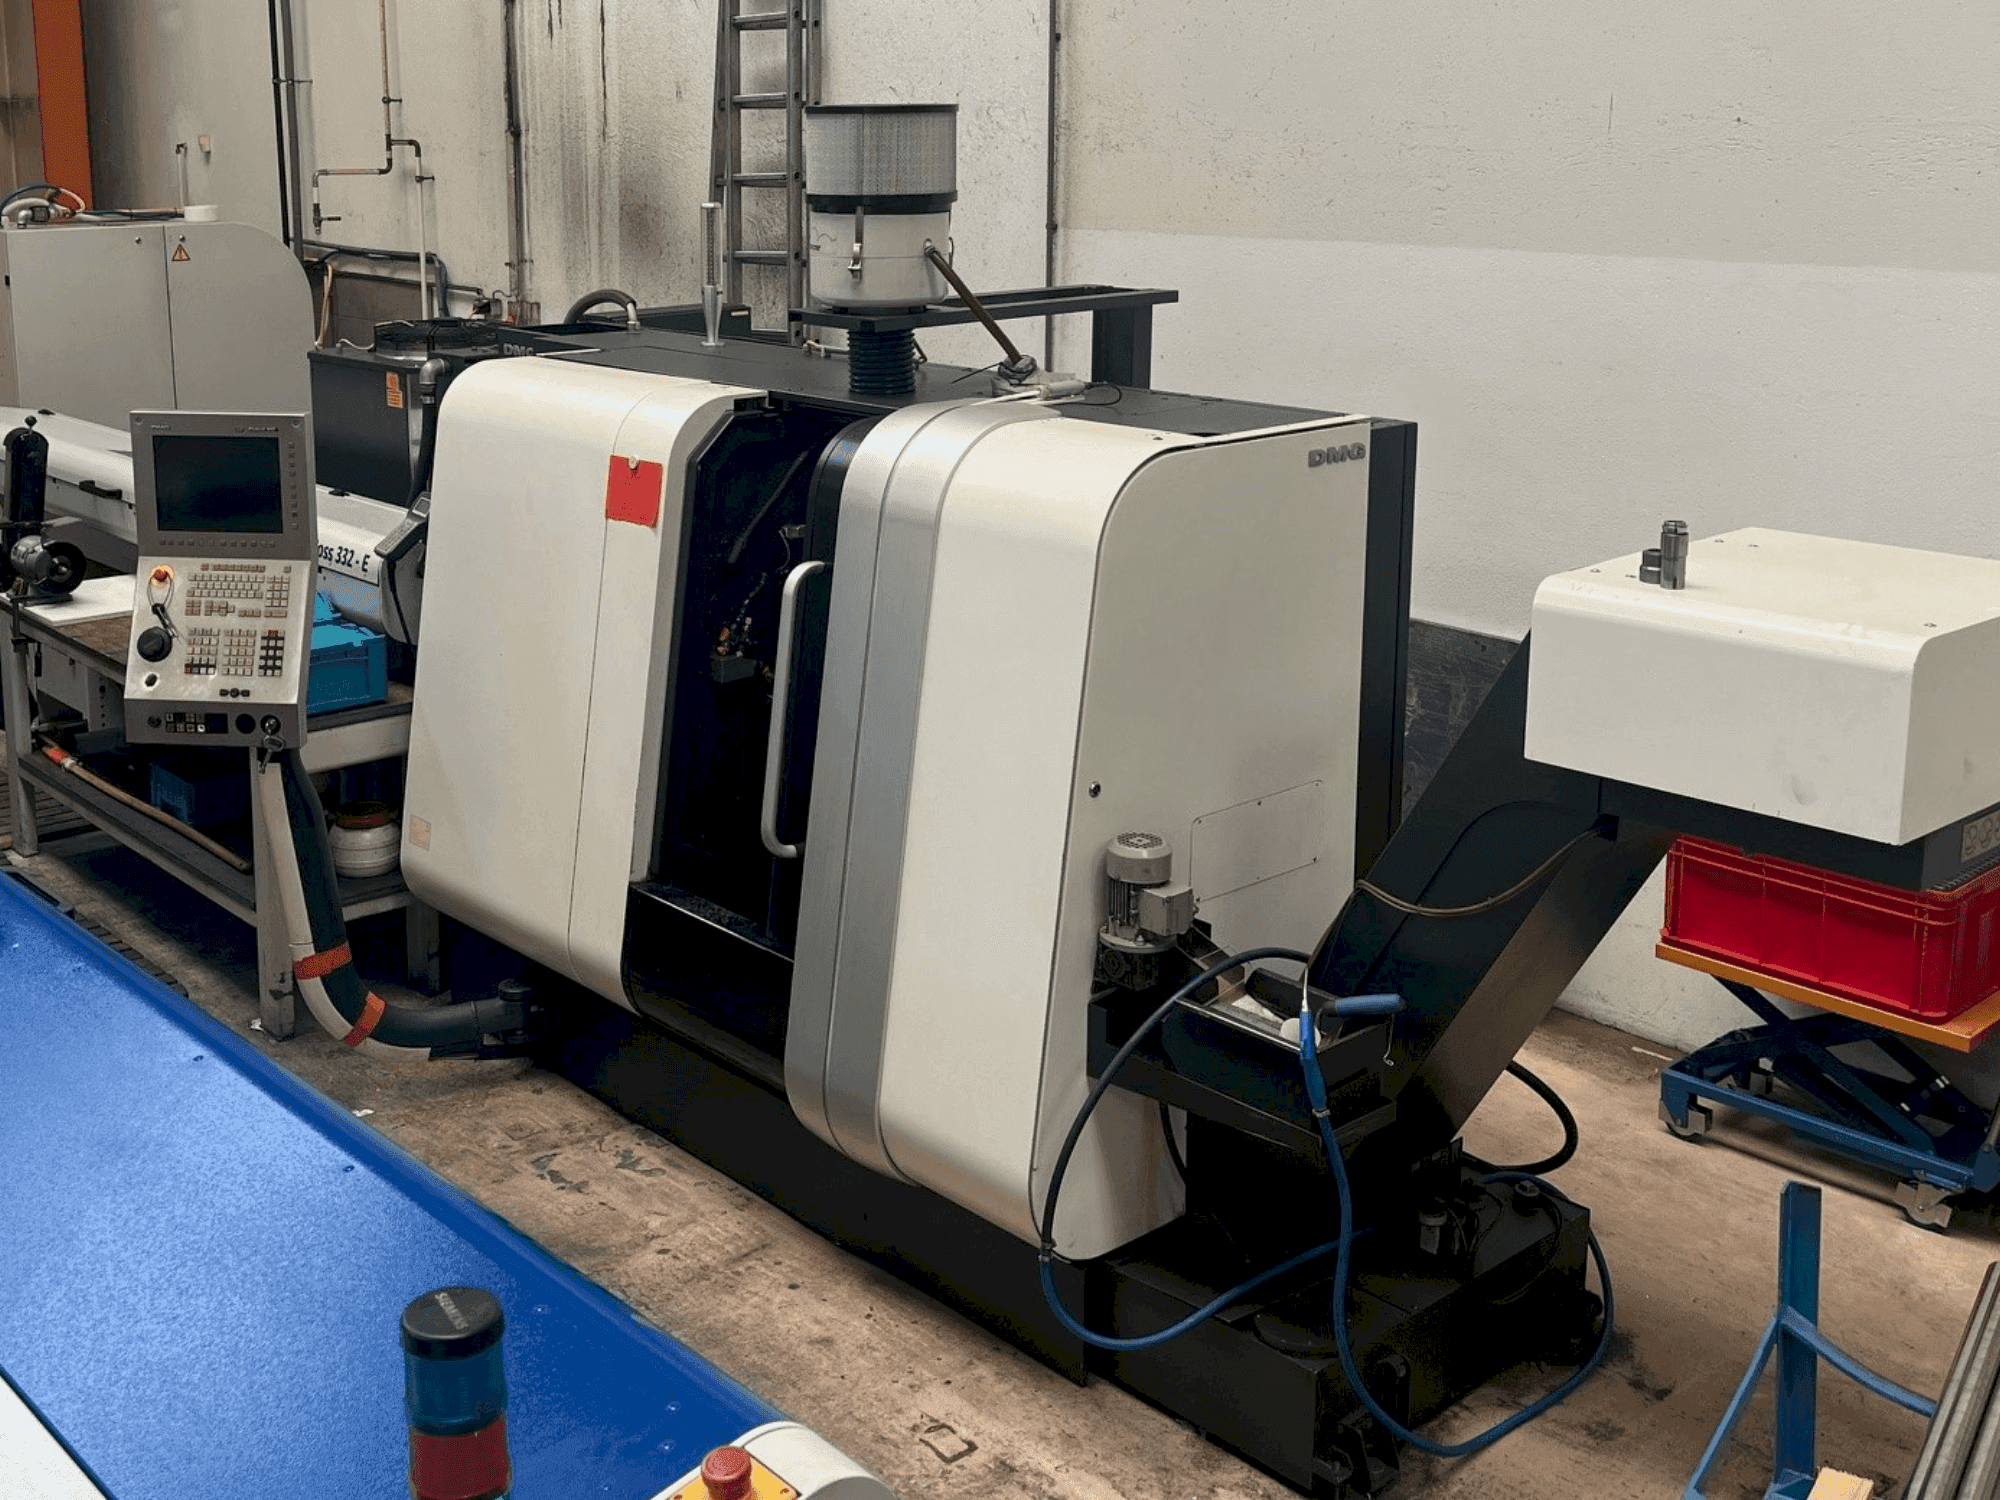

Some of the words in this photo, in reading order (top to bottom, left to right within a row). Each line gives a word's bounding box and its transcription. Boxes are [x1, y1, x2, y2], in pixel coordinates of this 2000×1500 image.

[1308, 442, 1366, 468] DMG
[317, 544, 334, 562] oss
[335, 546, 355, 568] 332
[361, 553, 371, 573] E
